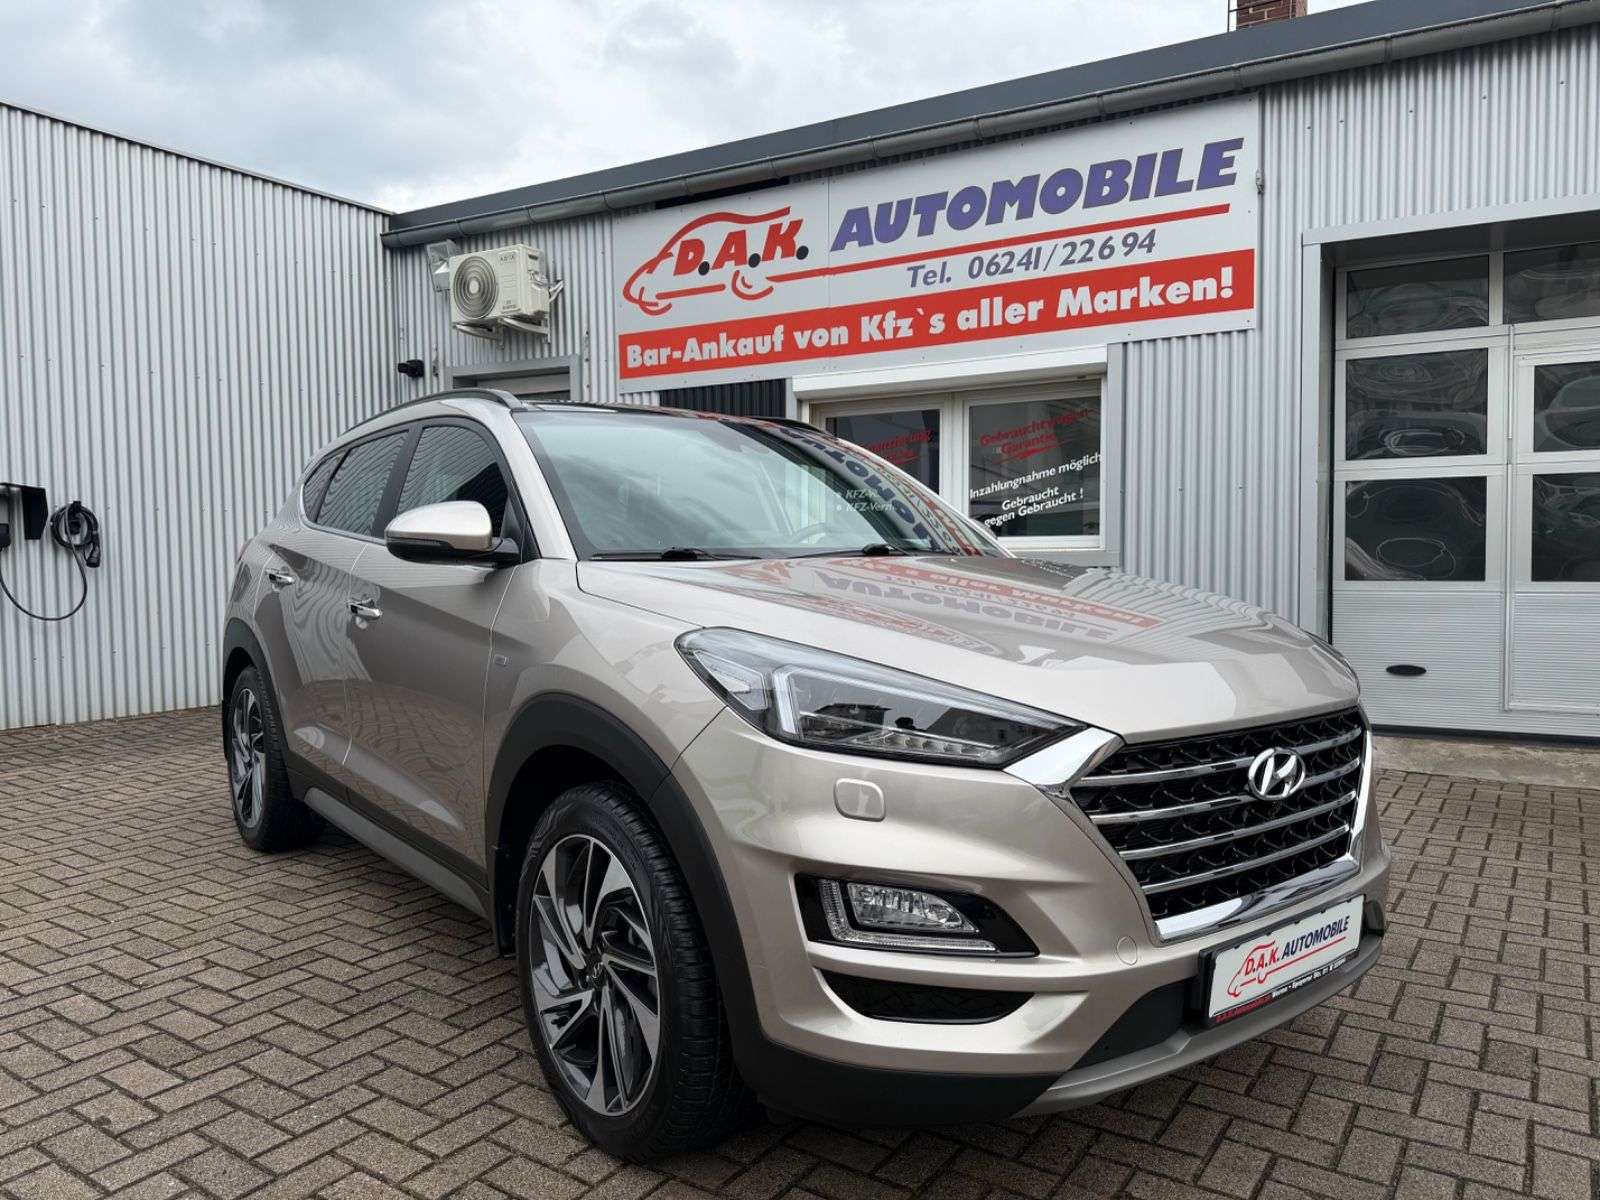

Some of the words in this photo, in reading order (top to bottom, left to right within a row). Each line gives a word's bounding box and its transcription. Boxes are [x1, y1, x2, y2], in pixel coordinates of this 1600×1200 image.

[673, 218, 809, 276] D.A.K.
[830, 137, 1245, 252] AUTOMOBILE
[907, 261, 952, 288] Tel.
[627, 325, 784, 368] Bar-Ankauf
[793, 326, 848, 350] von
[957, 296, 1044, 331] aller
[1056, 266, 1234, 318] Marken!
[984, 510, 1016, 529] gegen
[1018, 492, 1077, 517] Gebraucht
[1001, 487, 1060, 511] Gebraucht
[1245, 947, 1280, 976] D.A.K.
[1281, 915, 1350, 960] AUTOMOBILE
